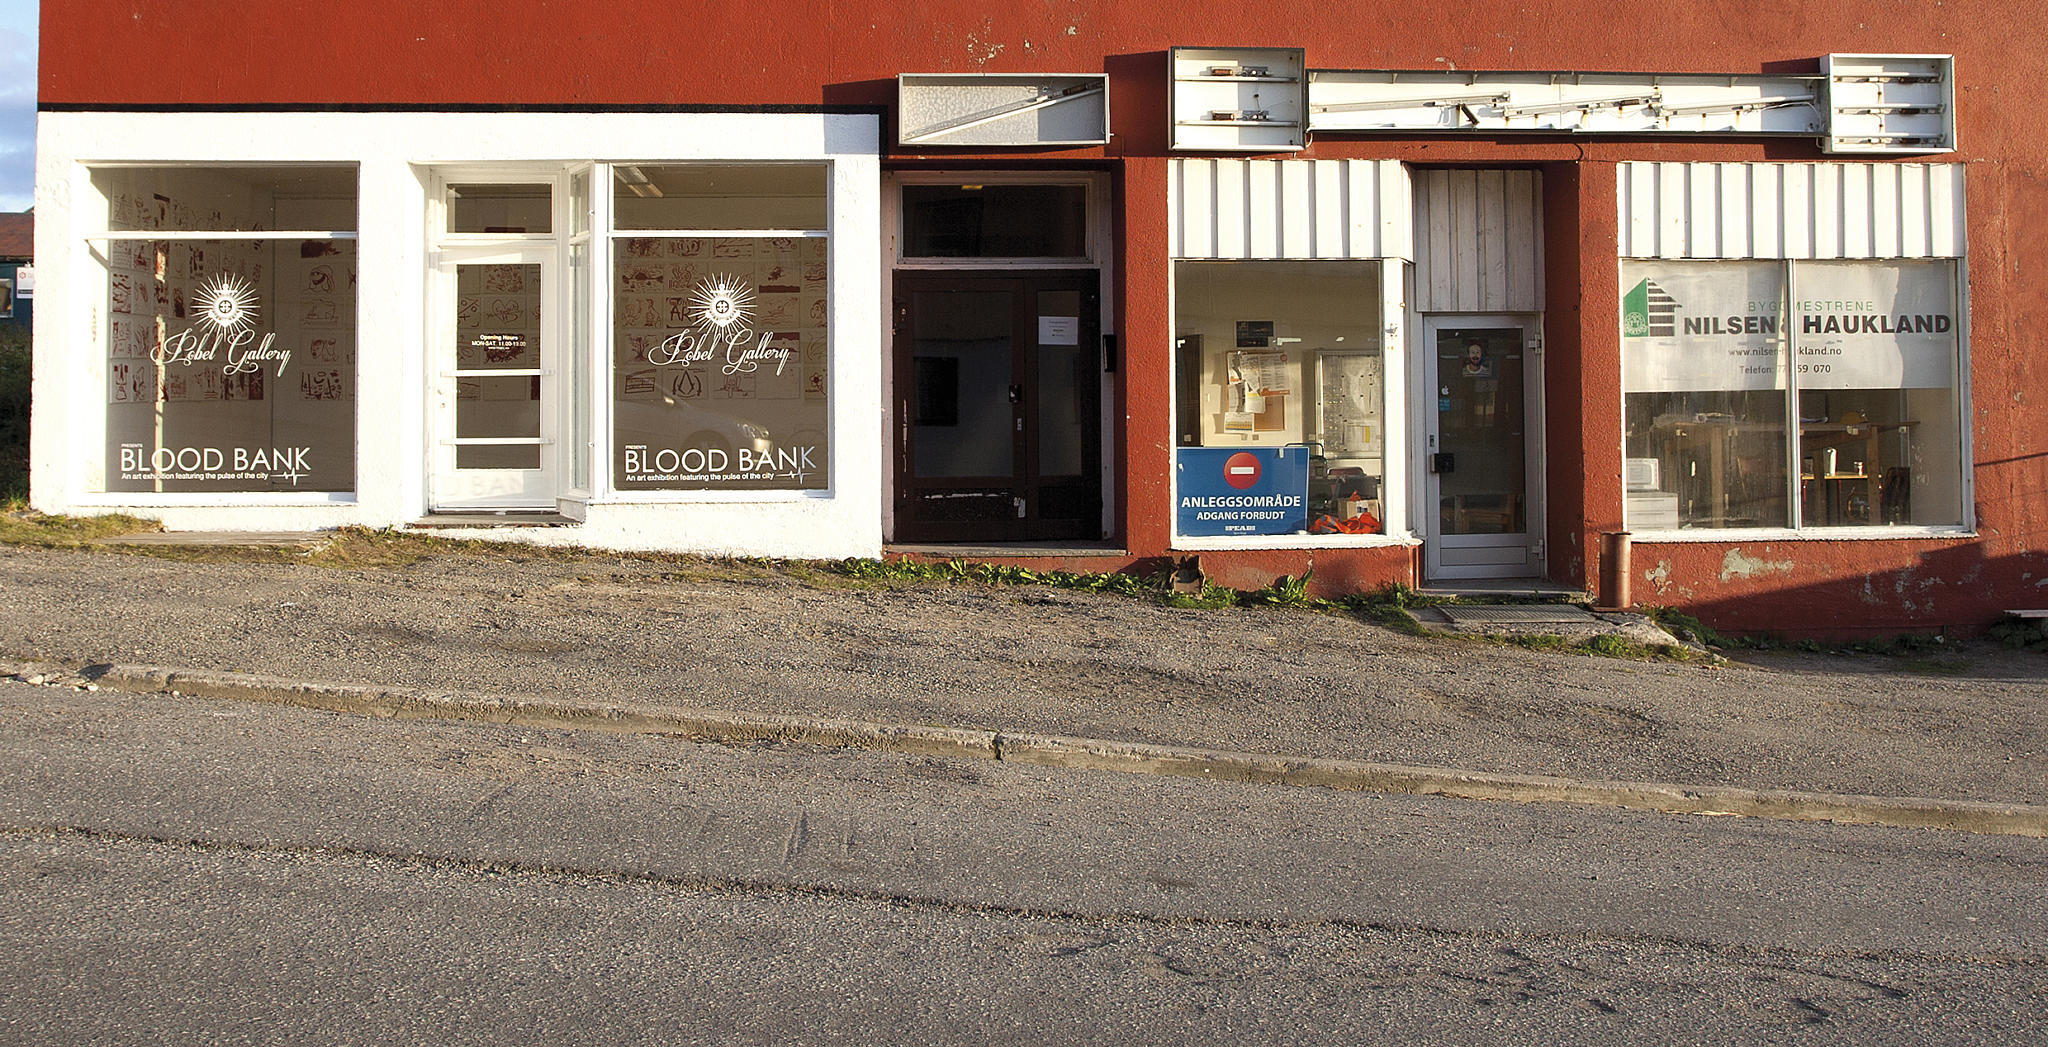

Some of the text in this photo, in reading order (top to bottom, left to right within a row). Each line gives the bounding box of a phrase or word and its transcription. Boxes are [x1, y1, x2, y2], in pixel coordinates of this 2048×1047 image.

[1684, 315, 1776, 335] NILSEN
[1803, 314, 1951, 334] HAUKLAND
[480, 333, 502, 341] Opening
[222, 329, 291, 377] Gallery
[721, 329, 790, 376] Gallery
[1813, 364, 1831, 373] 070
[120, 447, 312, 472] BLOOD BANK
[625, 446, 817, 473] BLOOD BANK
[175, 472, 204, 480] featuring
[205, 472, 217, 480] the
[217, 472, 236, 480] pulse
[236, 472, 244, 480] of
[244, 472, 256, 480] the
[256, 472, 269, 480] city
[626, 474, 636, 482] An
[637, 474, 646, 482] art
[679, 473, 709, 481] featuring
[722, 472, 741, 480] pulse
[741, 472, 749, 480] of
[749, 472, 761, 480] the
[762, 472, 775, 480] city
[1181, 494, 1301, 508] ANLEGGSOMRÅDE
[1196, 511, 1285, 521] ADGANG FORBUDT
